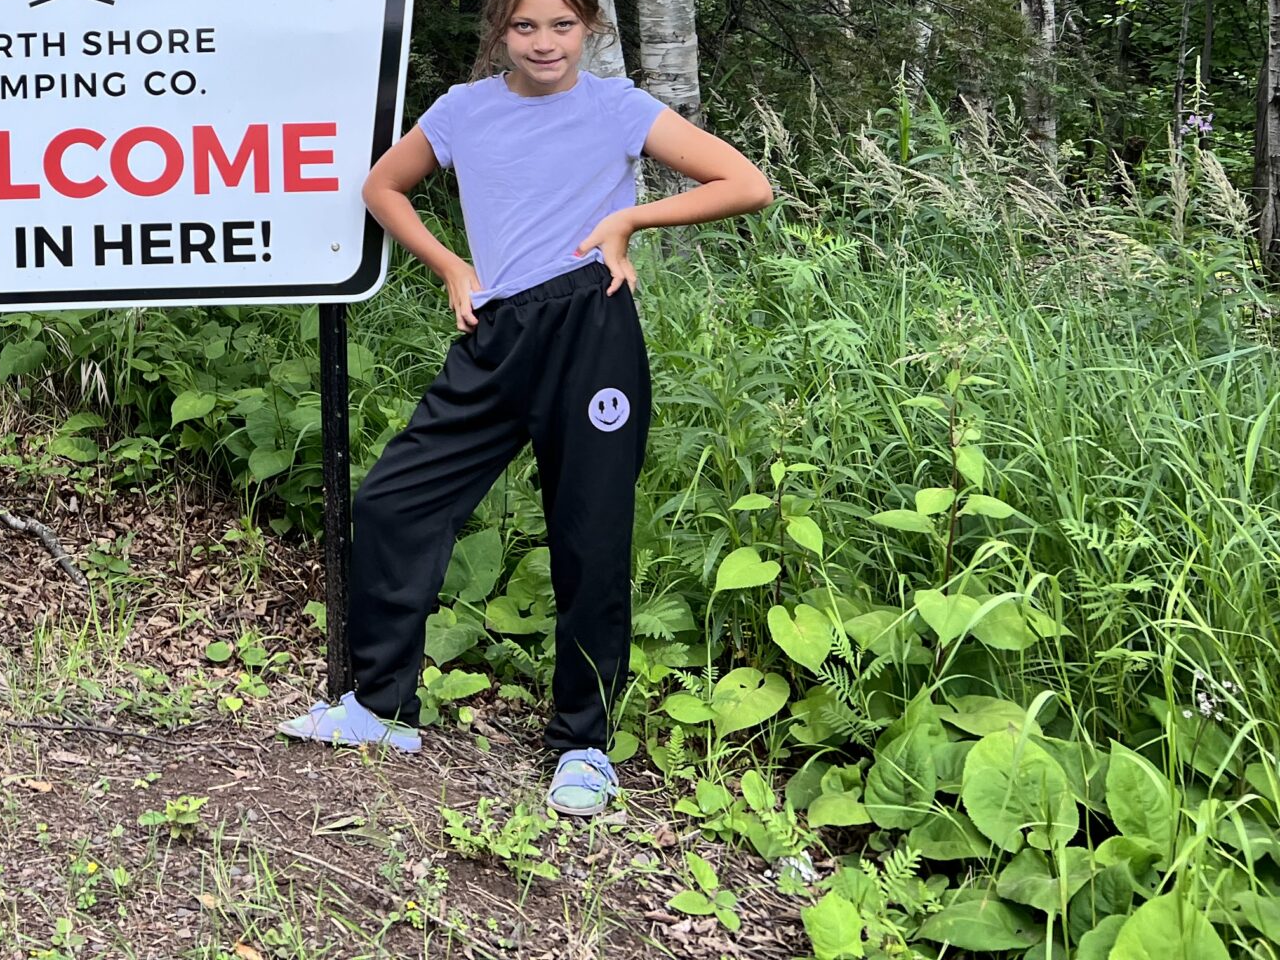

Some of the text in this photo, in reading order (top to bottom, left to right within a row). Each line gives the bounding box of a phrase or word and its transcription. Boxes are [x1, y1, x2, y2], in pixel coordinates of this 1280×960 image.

[82, 27, 216, 56] SHORE
[144, 70, 207, 96] CO.
[15, 225, 73, 269] IN
[94, 220, 272, 267] HERE!
